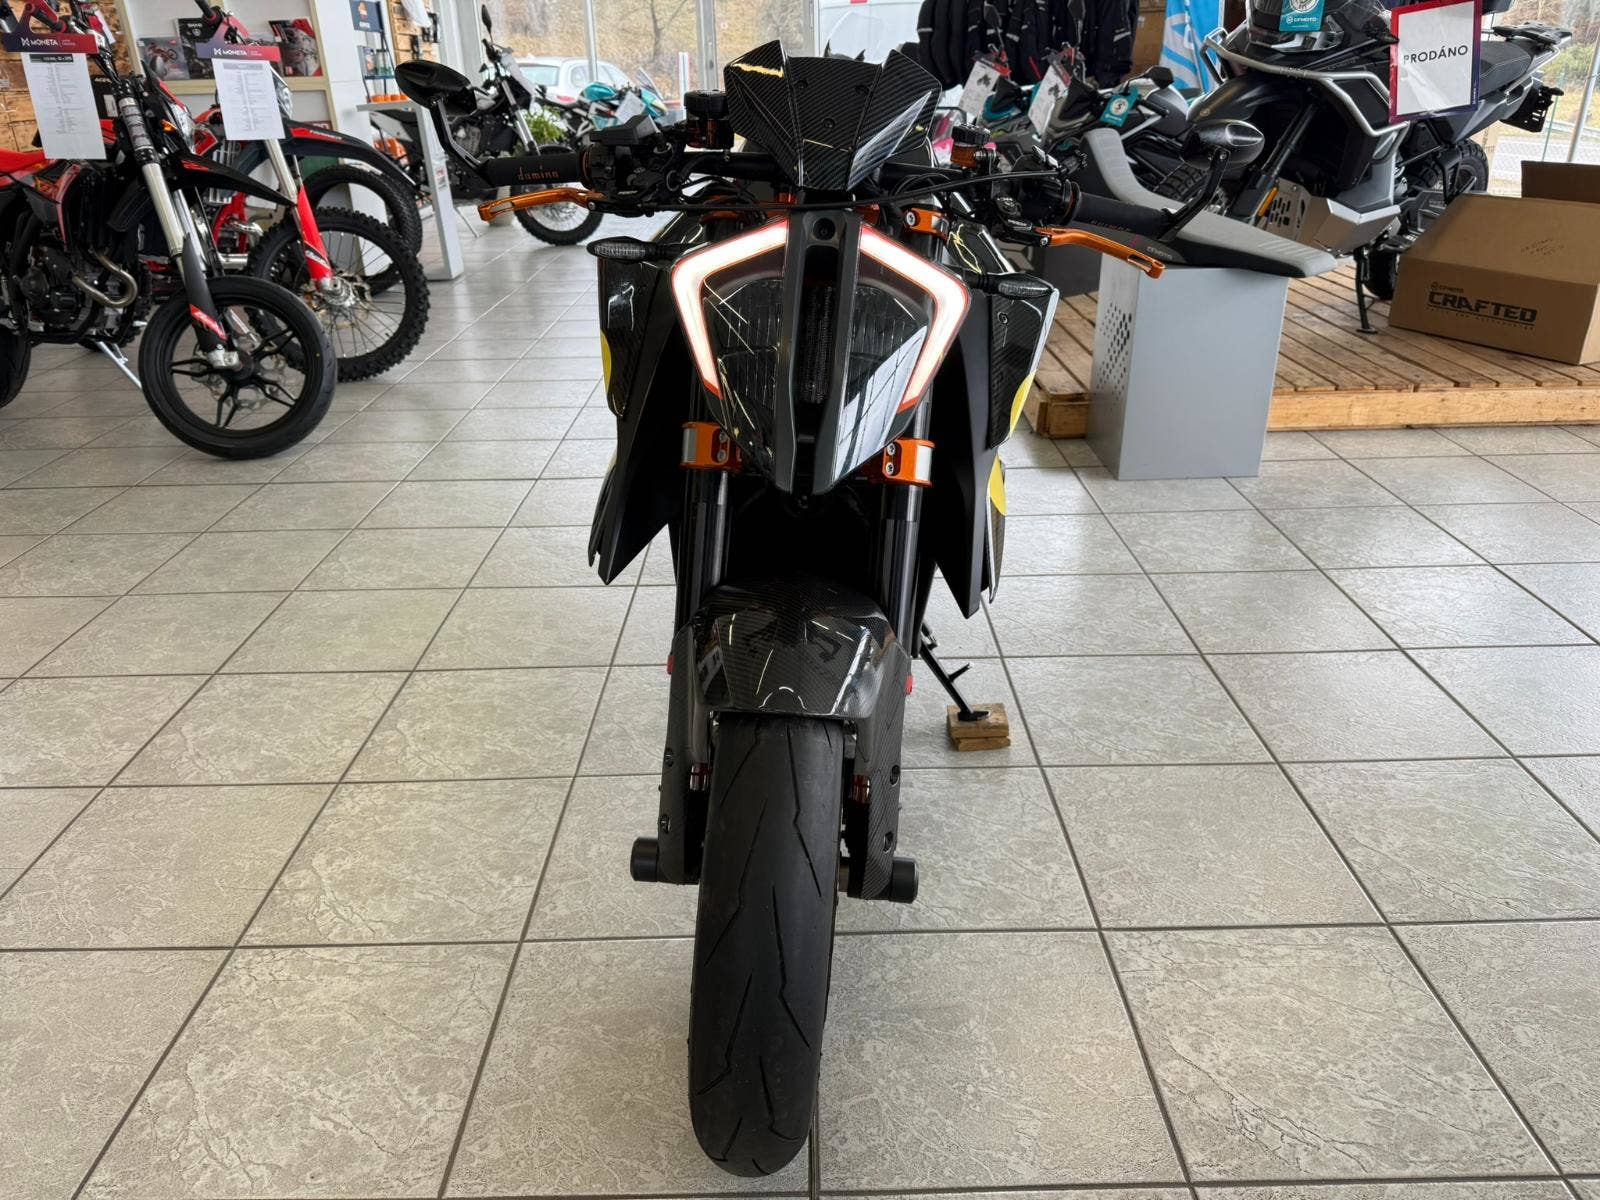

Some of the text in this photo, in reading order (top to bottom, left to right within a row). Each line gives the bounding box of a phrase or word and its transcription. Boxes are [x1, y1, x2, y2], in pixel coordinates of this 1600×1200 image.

[30, 38, 59, 46] MONETA
[1403, 45, 1469, 64] PRODÁNO
[1428, 291, 1538, 323] CRAFTED
